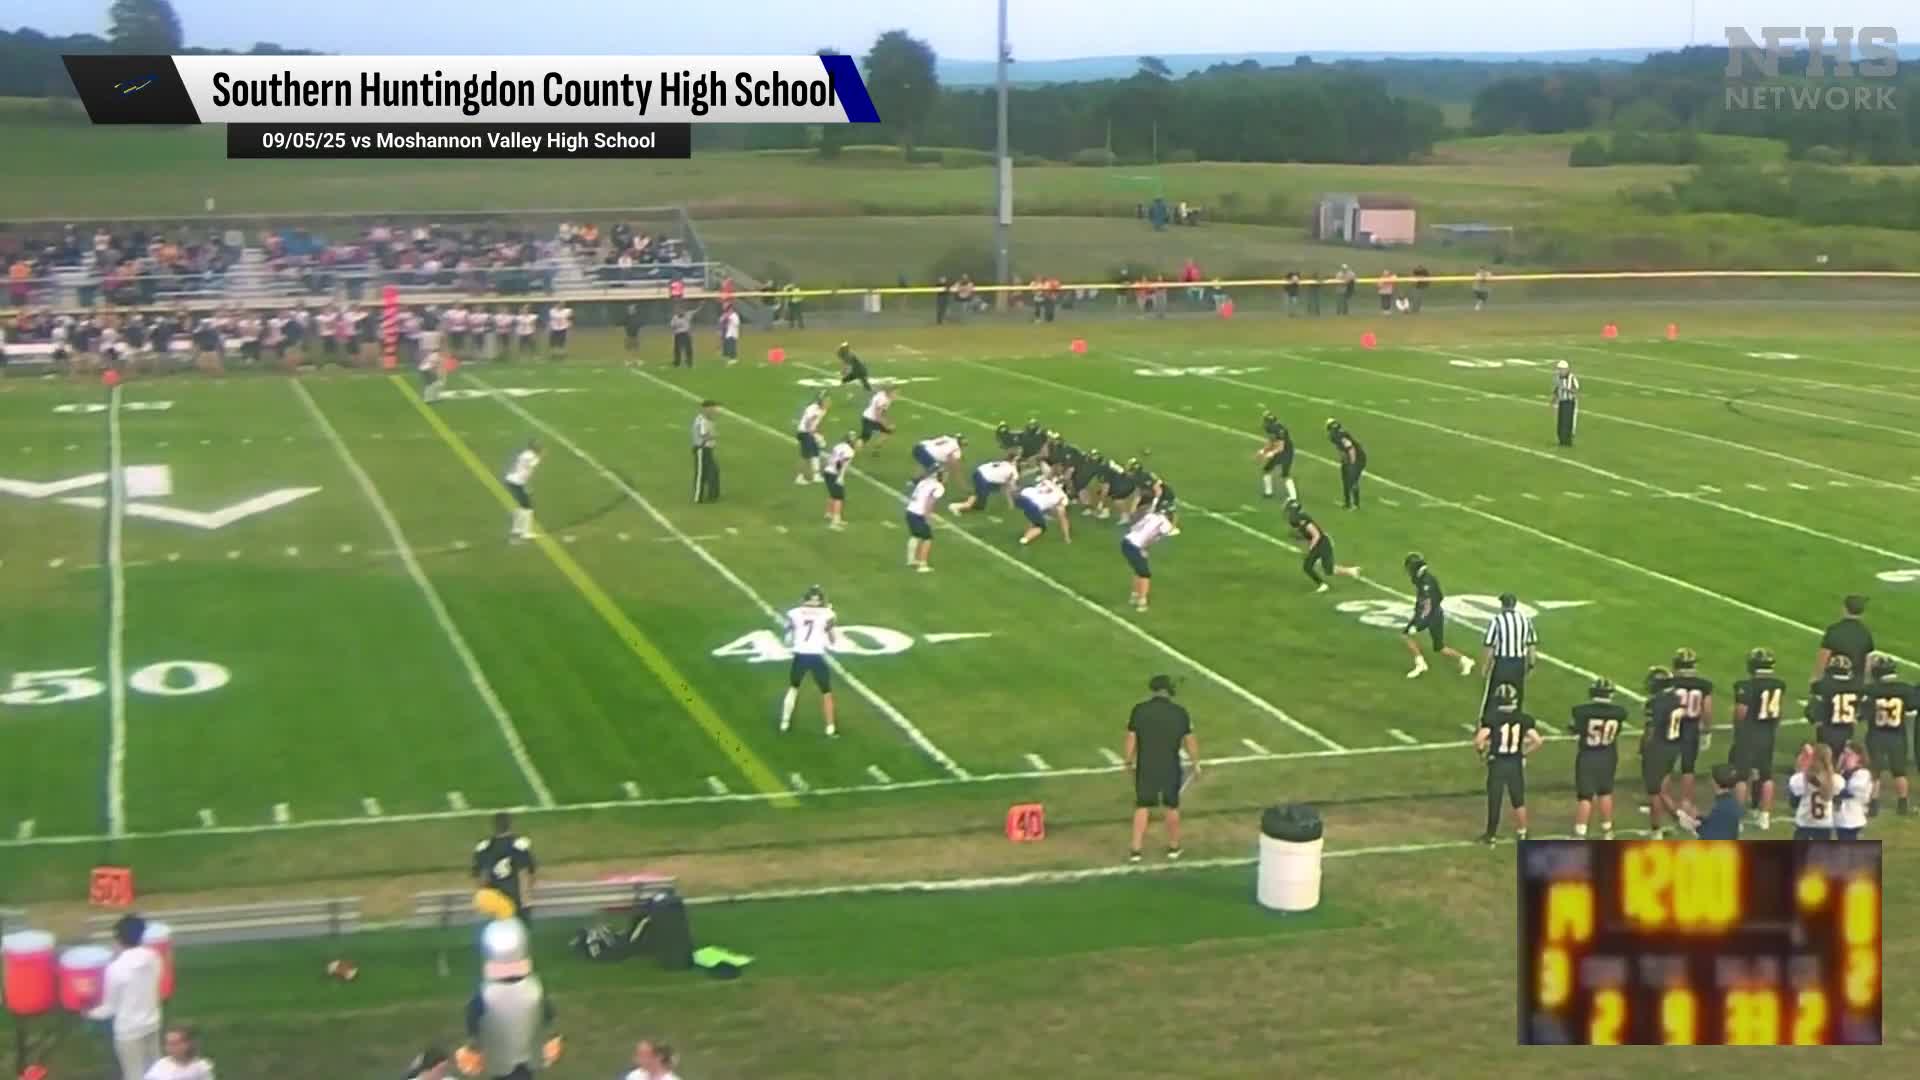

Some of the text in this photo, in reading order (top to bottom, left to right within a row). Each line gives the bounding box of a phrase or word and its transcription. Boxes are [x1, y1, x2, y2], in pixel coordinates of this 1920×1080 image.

[803, 620, 815, 642] 7
[0, 660, 232, 706] 50
[1758, 688, 1782, 720] 14
[1832, 693, 1857, 724] 15
[1498, 722, 1522, 754] 11
[1586, 719, 1619, 747] 50
[1811, 790, 1826, 820] 6
[1017, 810, 1043, 838] 40
